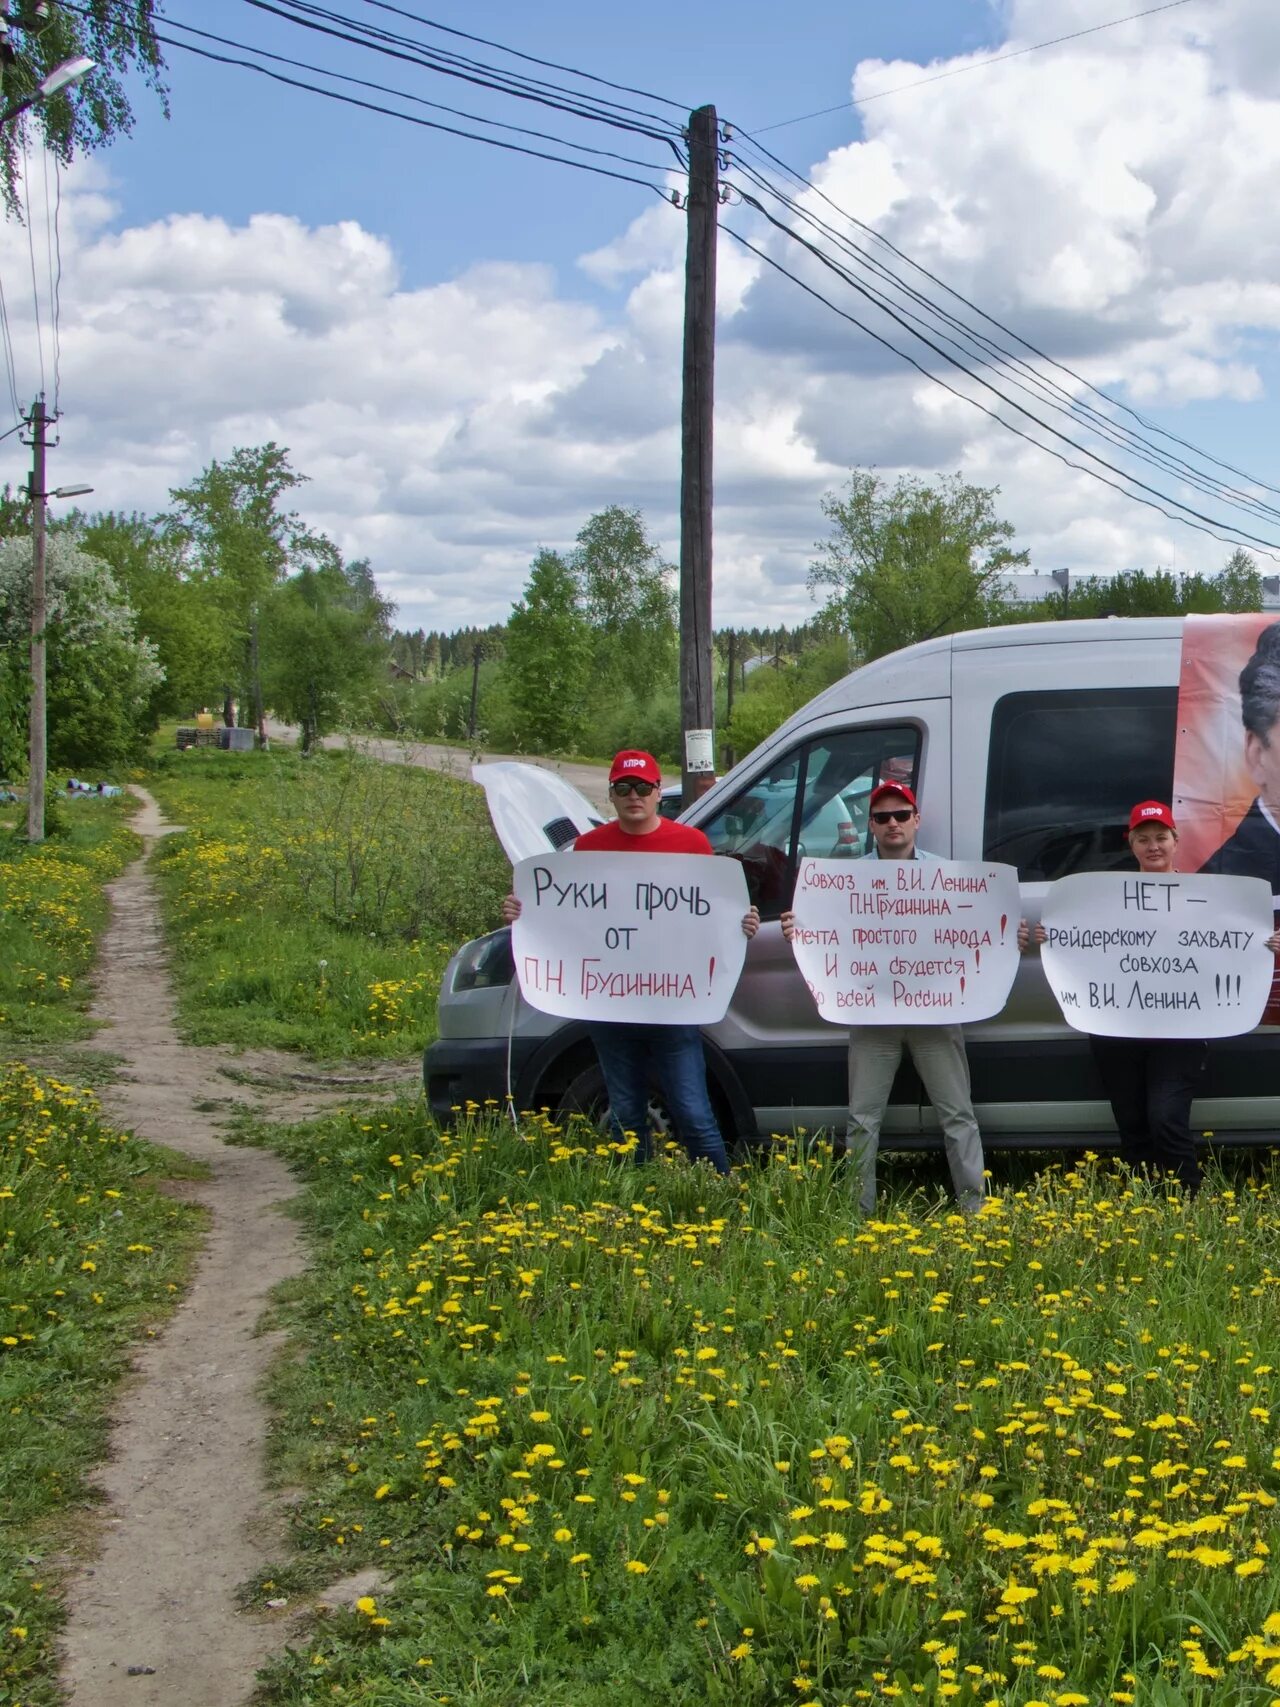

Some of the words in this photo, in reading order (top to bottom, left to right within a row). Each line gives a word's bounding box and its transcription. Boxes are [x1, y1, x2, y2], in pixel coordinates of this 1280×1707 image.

[623, 758, 646, 768] КПРФ
[872, 879, 889, 891] им.
[897, 868, 926, 892] В.И.
[533, 867, 608, 910] Руки
[636, 882, 711, 920] прочь
[1124, 880, 1180, 912] НЕТ
[852, 928, 917, 950] простого
[525, 957, 566, 996] П.Н.
[850, 961, 879, 976] она
[837, 985, 876, 1008] всей
[1061, 991, 1081, 1009] им.
[1089, 982, 1120, 1010] В.И.
